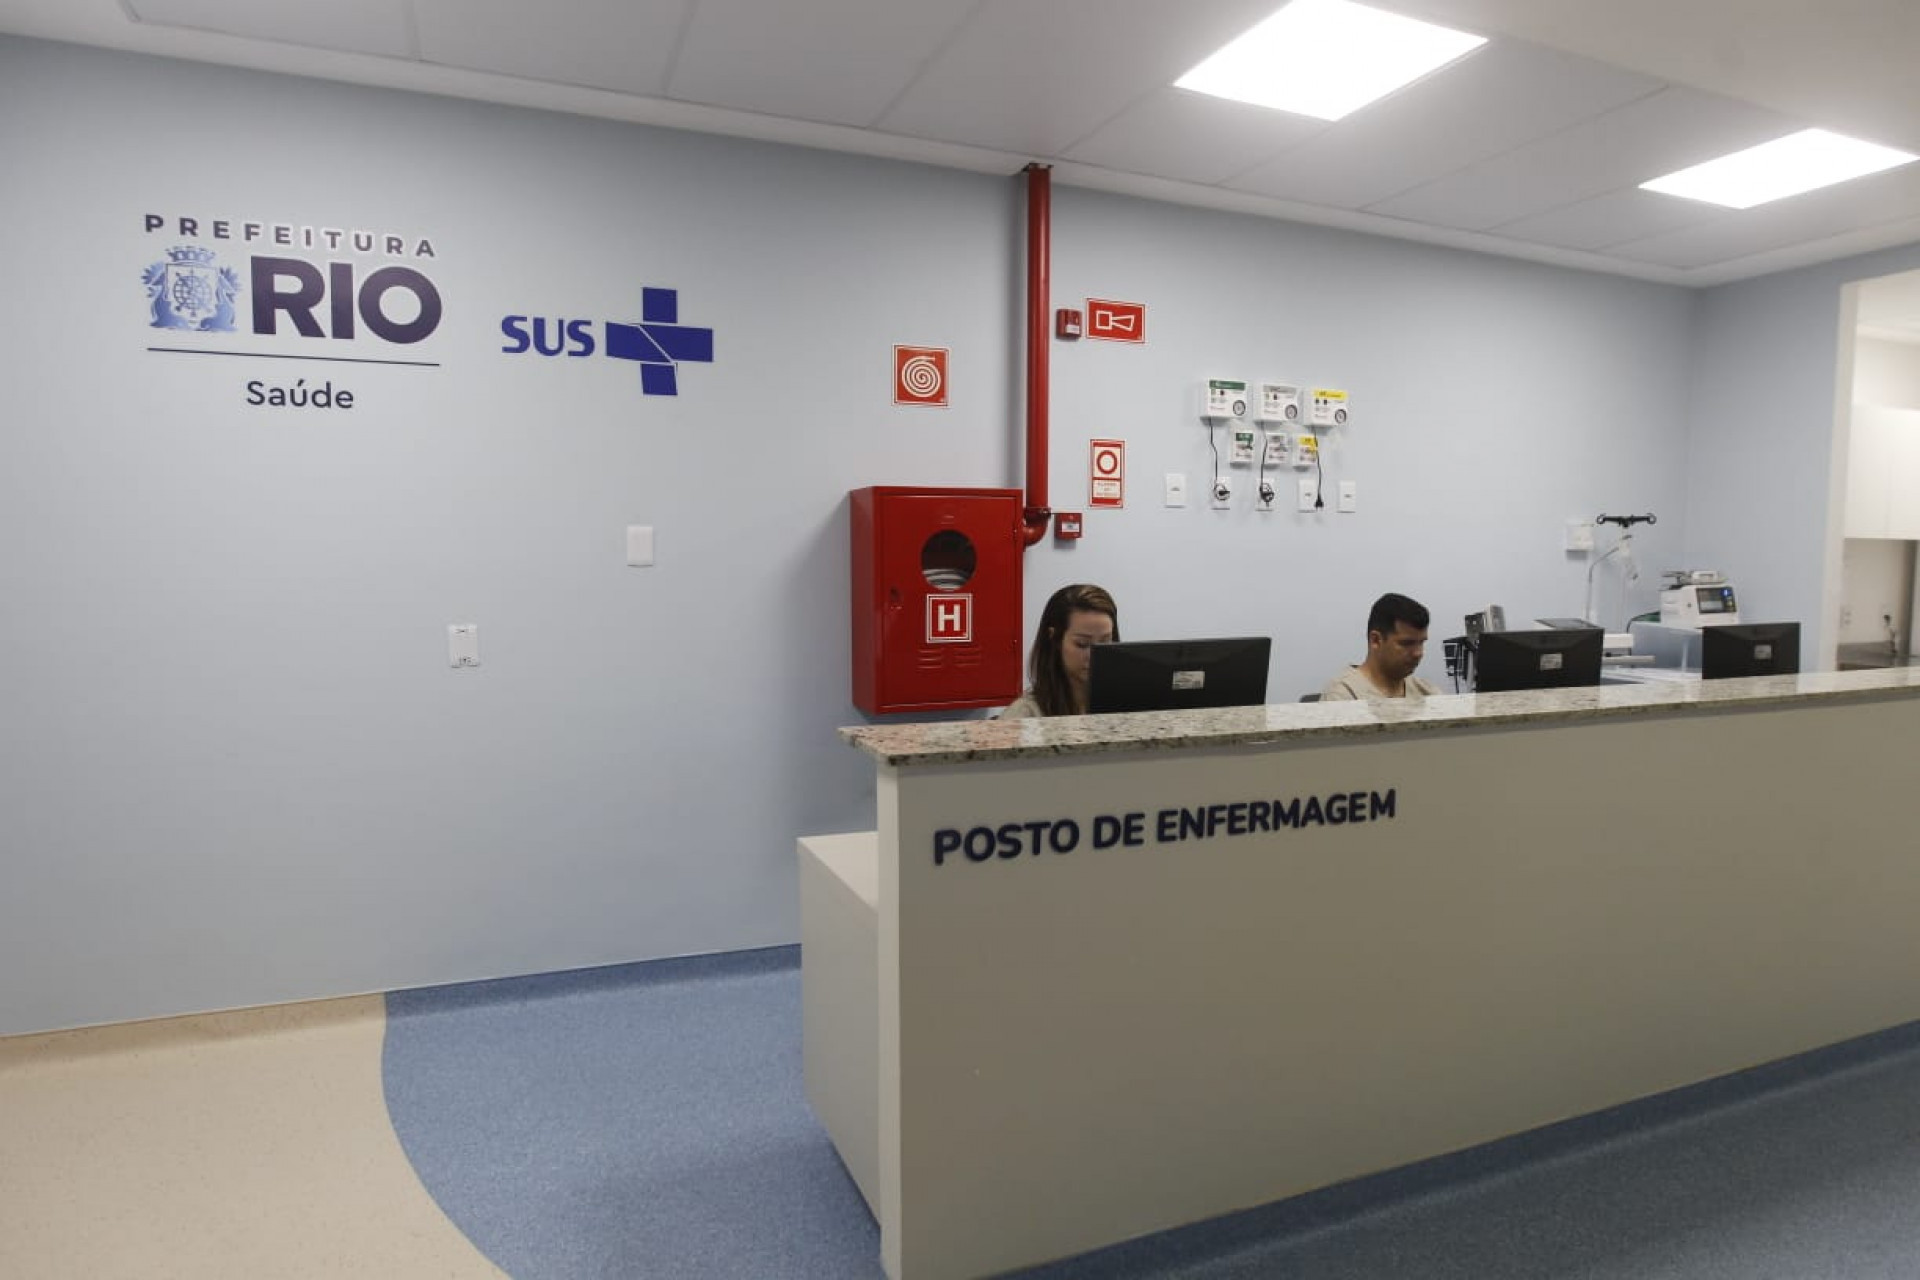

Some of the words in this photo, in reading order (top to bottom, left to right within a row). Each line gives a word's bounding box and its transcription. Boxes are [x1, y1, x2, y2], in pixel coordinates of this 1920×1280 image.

[144, 213, 435, 258] PREFEITURA
[250, 255, 443, 345] RIO
[501, 315, 596, 357] SUS
[246, 378, 354, 409] Saúde
[937, 604, 961, 632] H
[933, 818, 1080, 867] POSTO
[1092, 812, 1146, 850] DE
[1156, 788, 1396, 844] ENFERMAGEM
